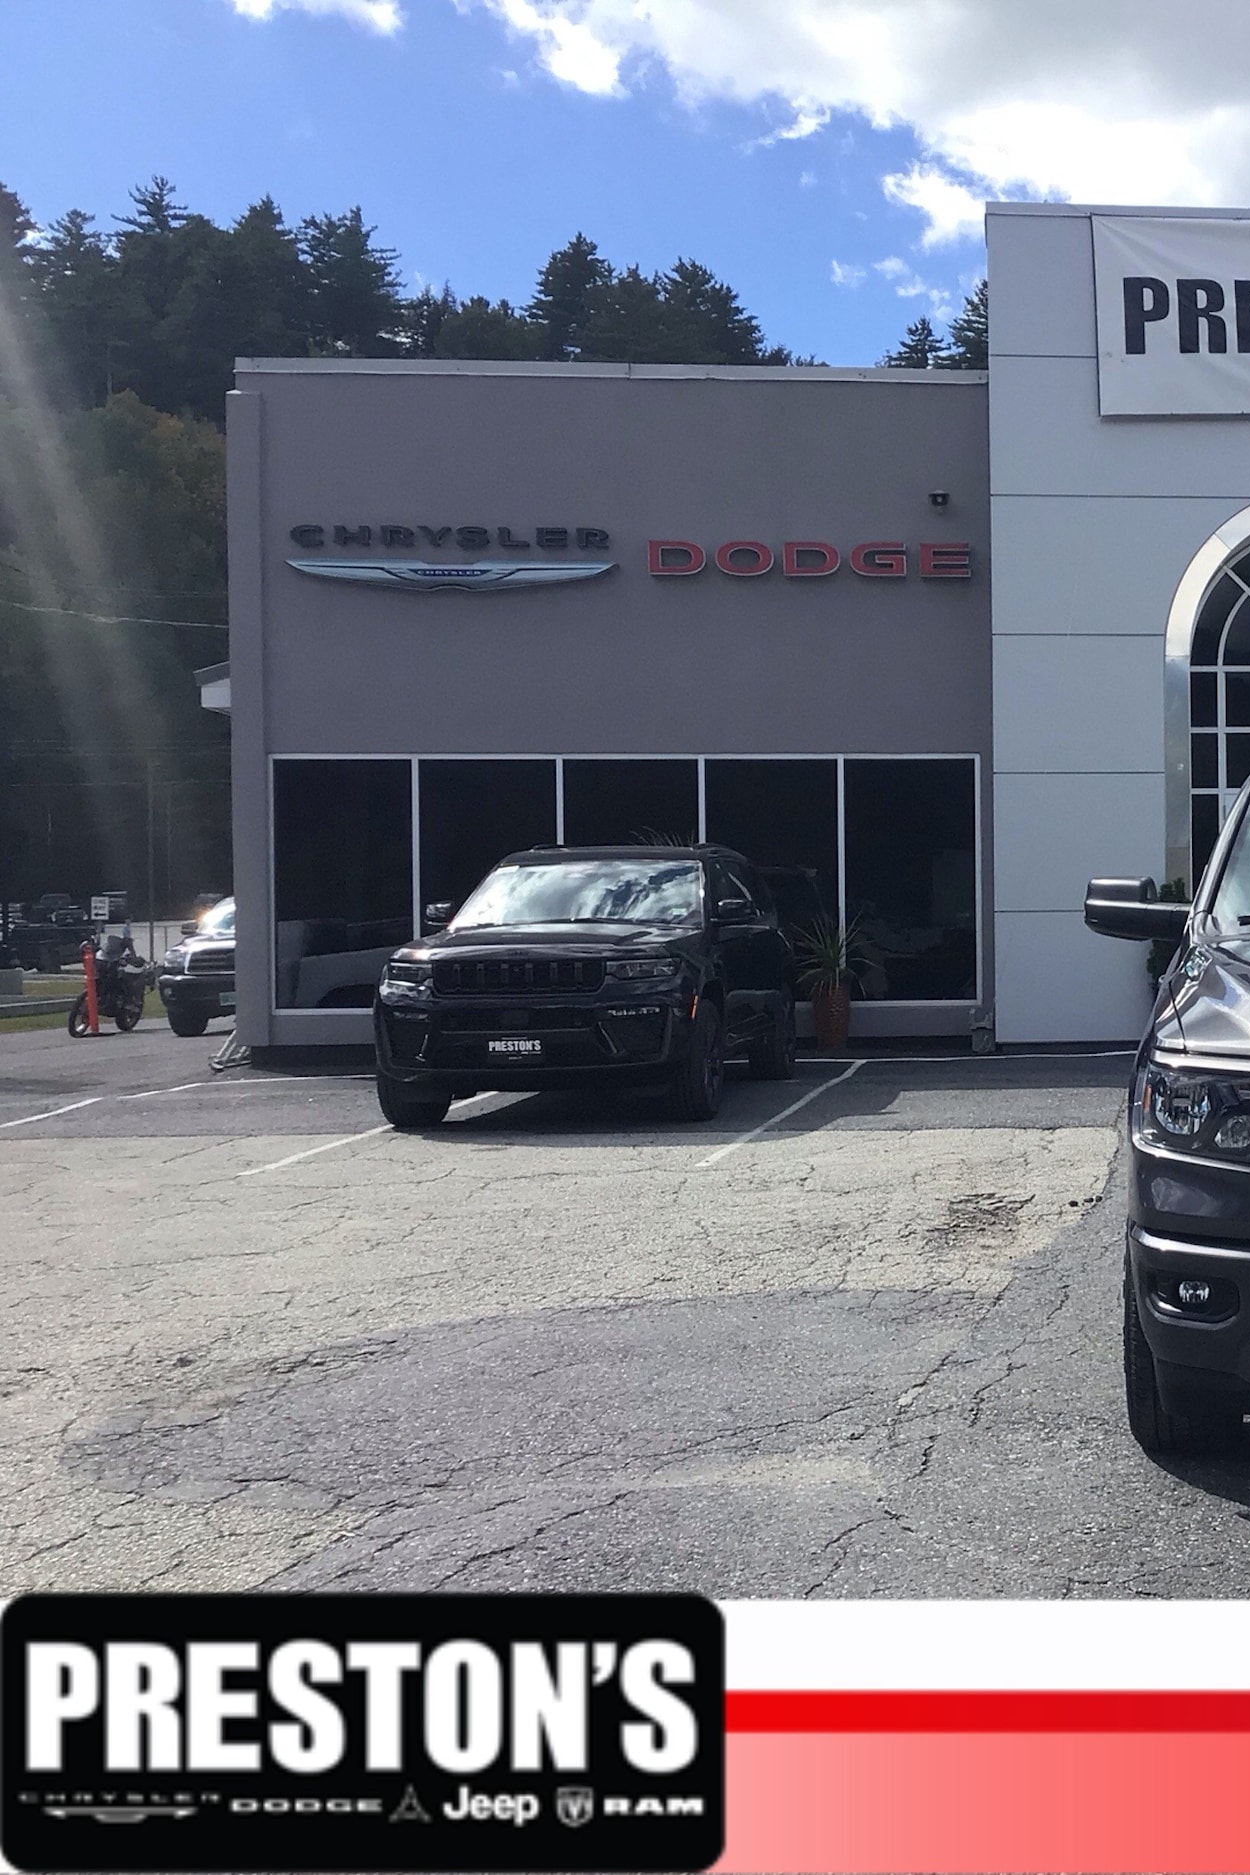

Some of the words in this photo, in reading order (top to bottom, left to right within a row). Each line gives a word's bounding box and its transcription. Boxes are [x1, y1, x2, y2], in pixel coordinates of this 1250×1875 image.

[289, 524, 610, 550] CHRYSLER
[647, 540, 971, 578] DODGE
[488, 1040, 541, 1052] PRESTON'S
